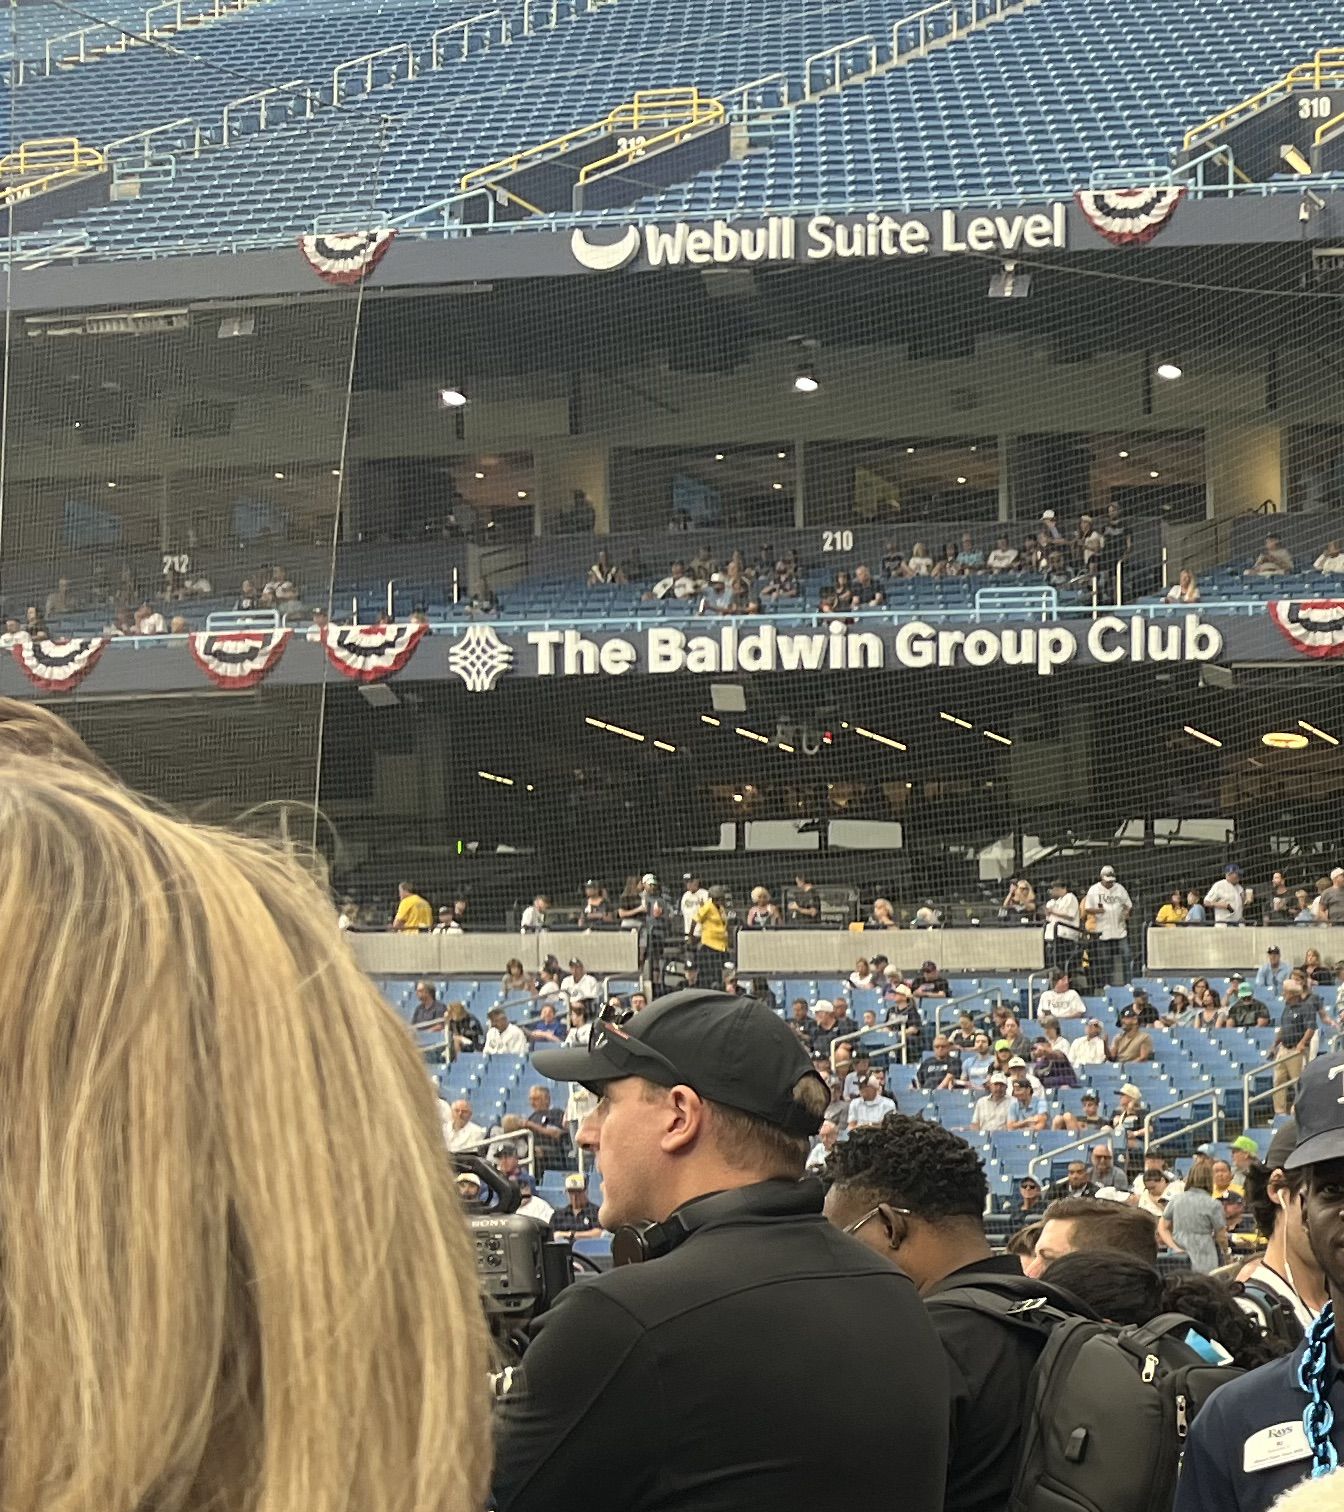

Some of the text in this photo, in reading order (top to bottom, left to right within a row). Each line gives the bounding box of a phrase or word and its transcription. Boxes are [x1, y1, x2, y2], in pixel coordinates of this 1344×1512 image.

[1298, 97, 1331, 119] 310
[617, 136, 646, 156] 312
[645, 202, 1066, 266] Webull Suite Level
[822, 530, 853, 551] 210
[528, 612, 1223, 677] The Baldwin Group Club
[471, 1219, 508, 1228] SONY
